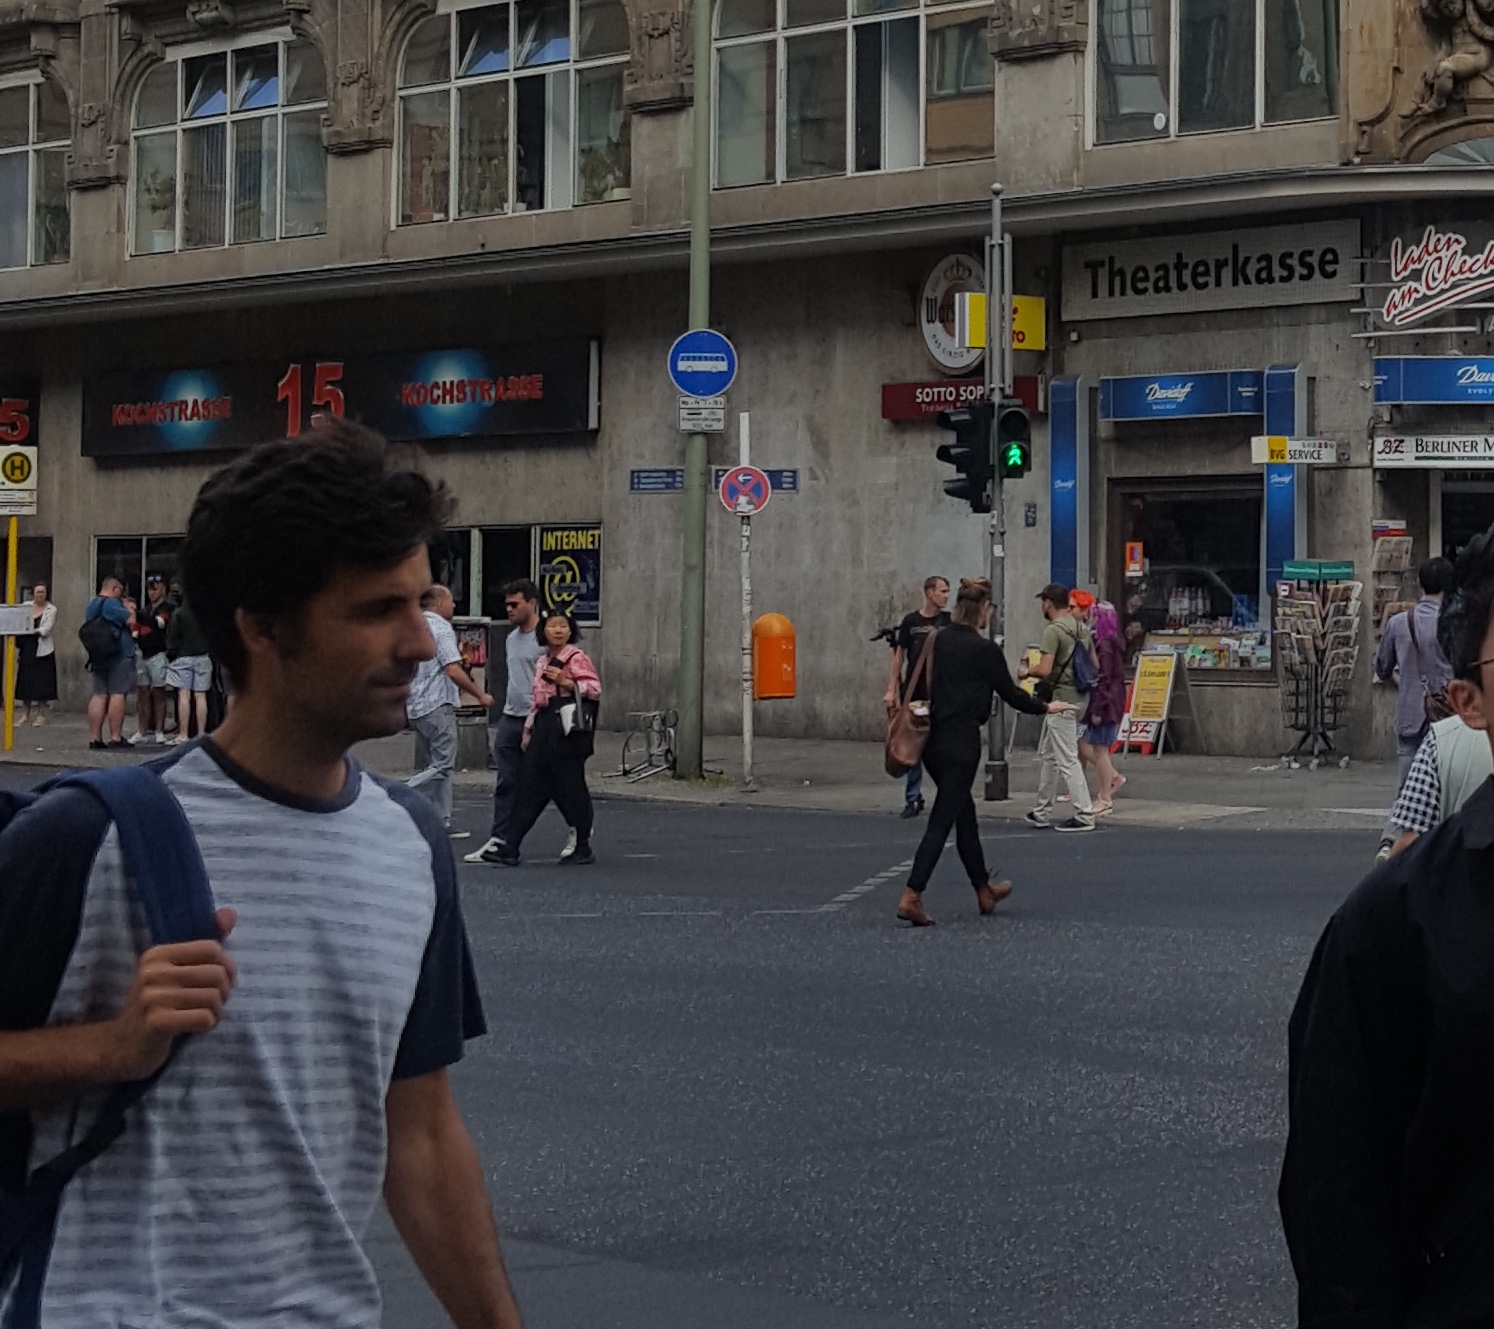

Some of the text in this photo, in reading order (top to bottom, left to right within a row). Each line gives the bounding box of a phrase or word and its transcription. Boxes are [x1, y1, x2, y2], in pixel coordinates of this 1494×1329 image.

[1084, 242, 1340, 299] Theaterkasse
[112, 362, 543, 438] KOCHSTRASSE 15 KOCHSTRASSE
[915, 387, 956, 403] SOTTO
[1270, 449, 1323, 460] BVG SERVICE
[1415, 438, 1479, 454] BERLINER
[543, 530, 601, 551] INTERNET
